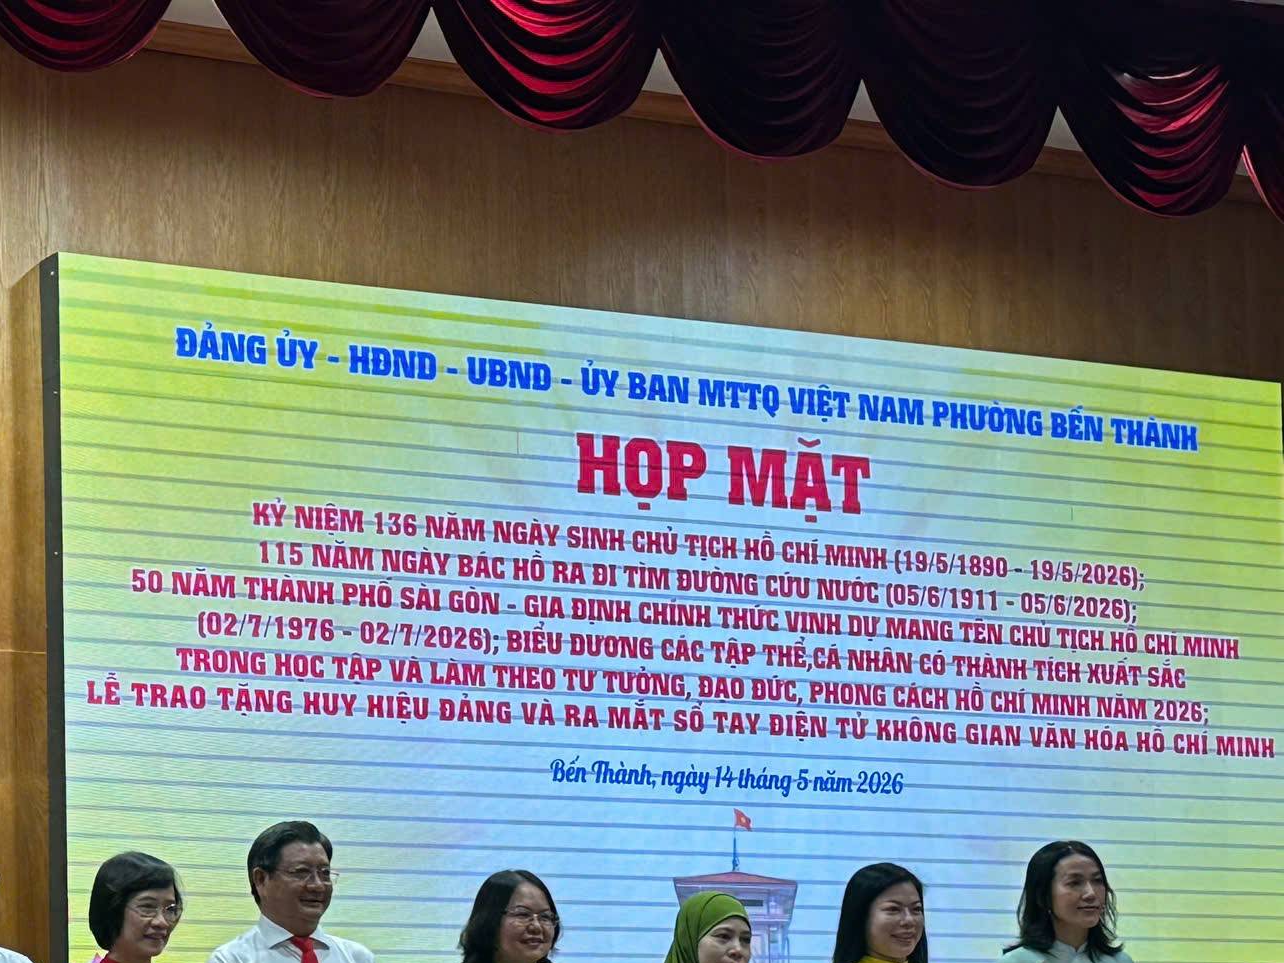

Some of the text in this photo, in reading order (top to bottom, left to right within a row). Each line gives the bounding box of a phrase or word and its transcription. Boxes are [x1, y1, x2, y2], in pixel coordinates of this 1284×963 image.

[176, 324, 266, 366] ĐẢNG
[276, 331, 318, 370] ỦY
[348, 345, 436, 381] HĐND
[466, 357, 551, 392] UBND
[580, 360, 619, 398] ỦY
[626, 372, 689, 404] BAN
[698, 378, 780, 417] MTTQ
[788, 385, 850, 423] VIỆT
[858, 393, 924, 426] NAM
[932, 400, 1042, 436] PHƯỜNG
[1050, 403, 1102, 442] BẾN
[1110, 416, 1198, 450] THÀNH
[576, 432, 870, 523] HỌP MẶT
[252, 497, 286, 528] KỶ
[294, 504, 364, 536] NIỆM
[374, 511, 417, 537] 136
[424, 512, 486, 542] NĂM
[492, 518, 560, 547] NGÀY
[566, 525, 624, 551] SINH
[632, 525, 678, 555] CHỦ
[684, 533, 738, 561] TỊCH
[744, 530, 774, 561] HỒ
[780, 538, 818, 564] CHÍ
[824, 544, 886, 569] MINH
[894, 548, 1008, 577] (19/5/1890
[1030, 558, 1144, 590] 19/5/2026);
[259, 542, 303, 568] 115
[310, 542, 374, 573] NĂM
[380, 548, 450, 577] NGÀY
[456, 551, 504, 581] BÁC
[512, 551, 544, 583] HỒ
[552, 561, 586, 586] RA
[592, 563, 617, 588] ĐI
[622, 562, 670, 591] TÌM
[676, 567, 758, 596] ĐƯỜNG
[764, 572, 810, 600] CỨU
[816, 576, 879, 604] NƯỚC
[886, 583, 998, 611] (05/6/1911
[1020, 592, 1136, 624] 05/6/2026);
[131, 569, 162, 595] 50
[170, 569, 236, 599] NĂM
[242, 575, 334, 605] THÀNH
[342, 576, 392, 609] PHỐ
[400, 583, 440, 612] SÀI
[448, 586, 500, 615] GÒN
[524, 594, 565, 619] GIA
[570, 597, 630, 625] ĐỊNH
[638, 599, 710, 628] CHÍNH
[716, 604, 778, 632] THỨC
[784, 610, 840, 636] VINH
[846, 614, 880, 642] DỰ
[884, 616, 953, 642] MANG
[958, 618, 1002, 645] TÊN
[1008, 619, 1050, 648] CHỦ
[1056, 627, 1104, 654] TỊCH
[1110, 623, 1138, 653] HỒ
[1144, 630, 1178, 656] CHÍ
[1182, 635, 1238, 660] MINH
[198, 614, 334, 644] (02/7/1976
[360, 623, 500, 657] 02/7/2026);
[506, 624, 562, 656] BIỂU
[570, 634, 652, 661] DƯƠNG
[660, 636, 704, 663] CÁC
[710, 638, 756, 669] TẬP
[846, 647, 912, 674] NHÂN
[918, 649, 946, 676] CÓ
[952, 652, 1027, 680] THÀNH
[1032, 656, 1081, 683] TÍCH
[1086, 655, 1142, 686] XUẤT
[1146, 657, 1186, 688] SẮC
[86, 673, 1276, 759] LỄ TRAO TẶNG HUY HIỆU ĐẢNG VÀ RA MẮT SỔ TAY ĐIỆN TỬ KHÔNG GIAN VĂN HÓA HỒ CHÍ MINH
[175, 649, 1208, 726] TRONG HỌC TẬP VÀ LÀM THEO TƯ TƯỞNG, ĐẠO ĐỨC, PHONG CÁCH HỒ CHÍ MINH NĂM 2026;
[550, 755, 903, 798] Bến Thành, ngày 14 tháng 5 năm 2026
